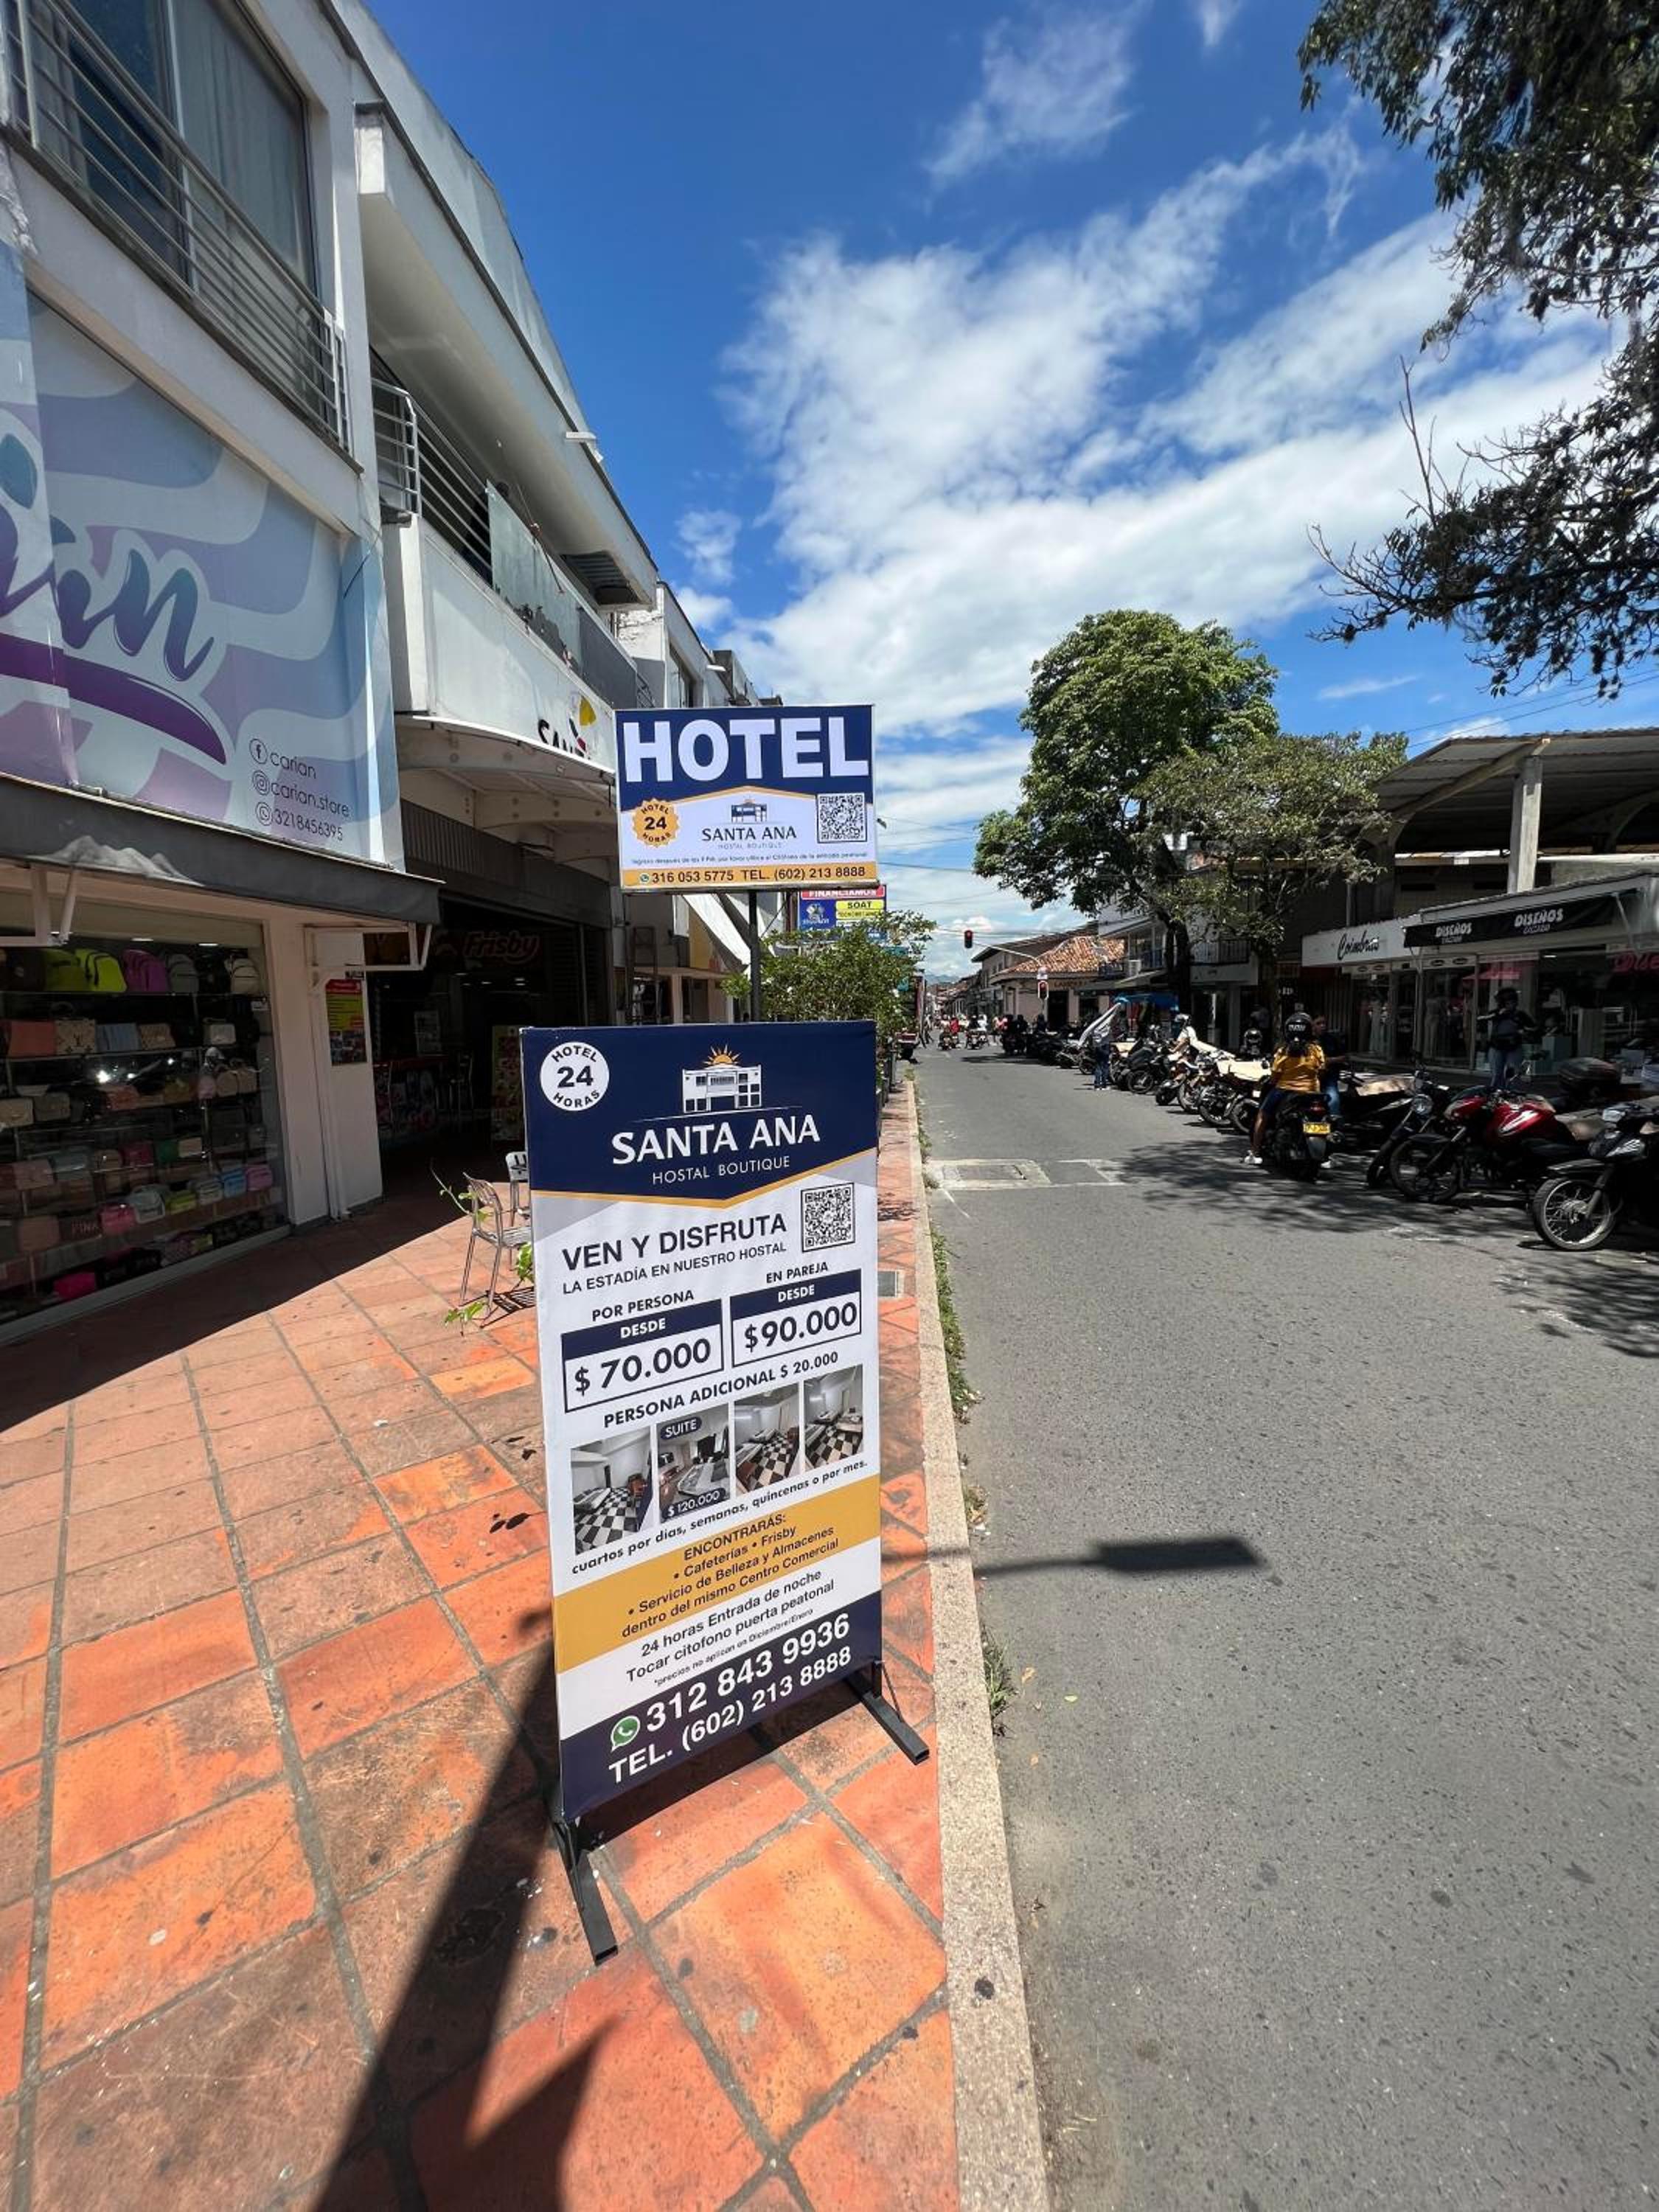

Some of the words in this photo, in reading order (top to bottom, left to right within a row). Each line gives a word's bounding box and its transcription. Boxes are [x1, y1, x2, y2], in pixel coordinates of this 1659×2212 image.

[270, 752, 316, 779] carian
[623, 716, 869, 782] HOTEL
[271, 782, 349, 818] carian.store
[641, 804, 669, 815] HOTEL
[275, 808, 343, 841] 3218456395
[643, 832, 671, 842] HORAS
[644, 816, 667, 830] 24
[702, 827, 756, 841] SANTA
[762, 825, 797, 841] ANA
[653, 872, 675, 883] 316
[678, 871, 700, 883] 053
[704, 870, 734, 881] 5775
[740, 869, 770, 880] TEL.
[774, 868, 805, 880] (602)
[809, 867, 831, 878] 213
[835, 866, 865, 877] 8888
[847, 901, 872, 909] SOAT
[462, 931, 541, 964] Frisby
[551, 1044, 599, 1063] HOTEL
[557, 1065, 594, 1089] 24
[554, 1090, 600, 1107] HORAS
[611, 1121, 737, 1165] SANTA
[750, 1114, 821, 1150] ANA
[652, 1164, 710, 1186] HOSTAL
[718, 1155, 790, 1177] BOUTIQUE
[562, 1242, 622, 1271] VEN
[630, 1235, 650, 1259] Y
[660, 1213, 787, 1254] DISFRUTA
[563, 1279, 582, 1295] LA
[586, 1266, 647, 1291] ESTADÍA
[651, 1263, 669, 1278] EN
[673, 1251, 736, 1273] NUESTRO
[739, 1242, 787, 1260] HOSTAL
[765, 1271, 782, 1284] EN
[786, 1262, 829, 1280] PAREJA
[592, 1304, 622, 1321] POR
[627, 1290, 695, 1314] PERSONA
[777, 1284, 815, 1304] DESDE
[619, 1318, 667, 1339] DESDE
[744, 1301, 858, 1352] $90.000
[574, 1366, 591, 1396] $
[600, 1338, 711, 1388] 70.000
[603, 1394, 685, 1428] PERSONA
[689, 1368, 776, 1404] ADICIONAL
[780, 1363, 789, 1380] $
[793, 1351, 838, 1374] 20.000
[664, 1419, 698, 1439] SUITE
[572, 1547, 624, 1574] cuartos
[627, 1538, 651, 1556] por
[655, 1526, 686, 1543] dias,
[690, 1502, 748, 1531] semanas,
[752, 1478, 809, 1508] quincenas
[812, 1477, 819, 1485] o
[822, 1469, 841, 1484] por
[843, 1461, 867, 1474] mes.
[668, 1506, 675, 1517] $
[678, 1491, 720, 1512] 120.000
[684, 1513, 786, 1561] ENCONTRARÁS:
[684, 1544, 748, 1578] Cafeterías
[761, 1526, 797, 1547] Frisby
[639, 1584, 692, 1613] Servicio
[696, 1574, 712, 1588] de
[716, 1557, 759, 1582] Belleza
[762, 1553, 769, 1565] y
[773, 1526, 835, 1559] Almacenes
[622, 1610, 667, 1638] dentro
[670, 1601, 690, 1617] del
[694, 1583, 736, 1607] mismo
[739, 1565, 779, 1587] Centro
[782, 1538, 839, 1568] Comercial
[641, 1640, 660, 1658] 24
[663, 1624, 704, 1649] horas
[709, 1597, 761, 1627] Entrada
[765, 1587, 779, 1602] de
[784, 1570, 822, 1596] noche
[626, 1655, 670, 1683] Tocar
[674, 1628, 732, 1660] citofono
[735, 1608, 778, 1635] puerta
[782, 1579, 835, 1615] peatonal
[647, 1681, 707, 1732] 312
[717, 1649, 773, 1697] 843
[782, 1613, 850, 1664] 9936
[692, 1660, 704, 1671] no
[706, 1645, 735, 1664] aplican
[609, 1741, 672, 1784] TEL.
[681, 1700, 744, 1750] (602)
[751, 1678, 793, 1713] 213
[800, 1646, 852, 1686] 8888
